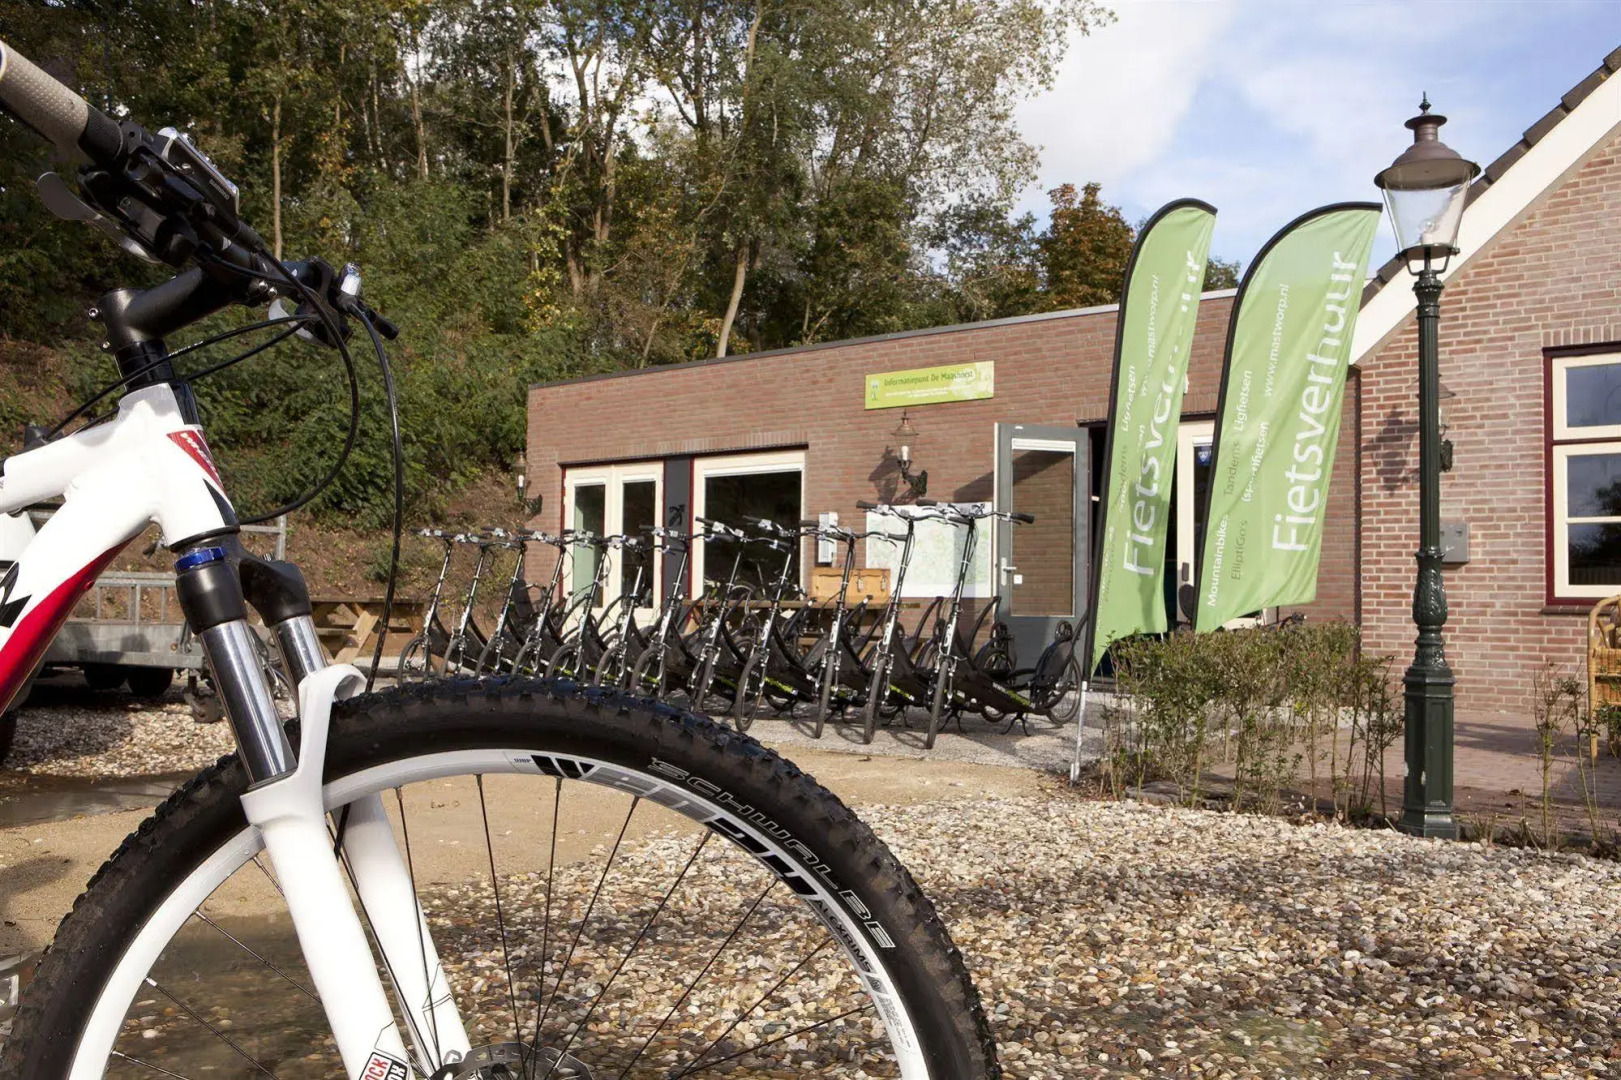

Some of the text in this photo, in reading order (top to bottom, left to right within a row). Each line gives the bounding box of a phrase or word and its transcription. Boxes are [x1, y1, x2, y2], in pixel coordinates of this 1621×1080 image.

[884, 375, 929, 386] Informatiepunt
[931, 373, 940, 382] De
[1140, 275, 1159, 397] wmastworp.nl
[1264, 284, 1290, 397] www.mastworp.nl
[1123, 251, 1200, 575] Fietsverr
[1272, 251, 1357, 552] Fietsverhuur
[1223, 442, 1241, 497] Tandems
[1241, 421, 1270, 502] (spt)fietsen
[648, 756, 897, 949] SCHWALBE
[813, 899, 873, 974] ALEXRIMS
